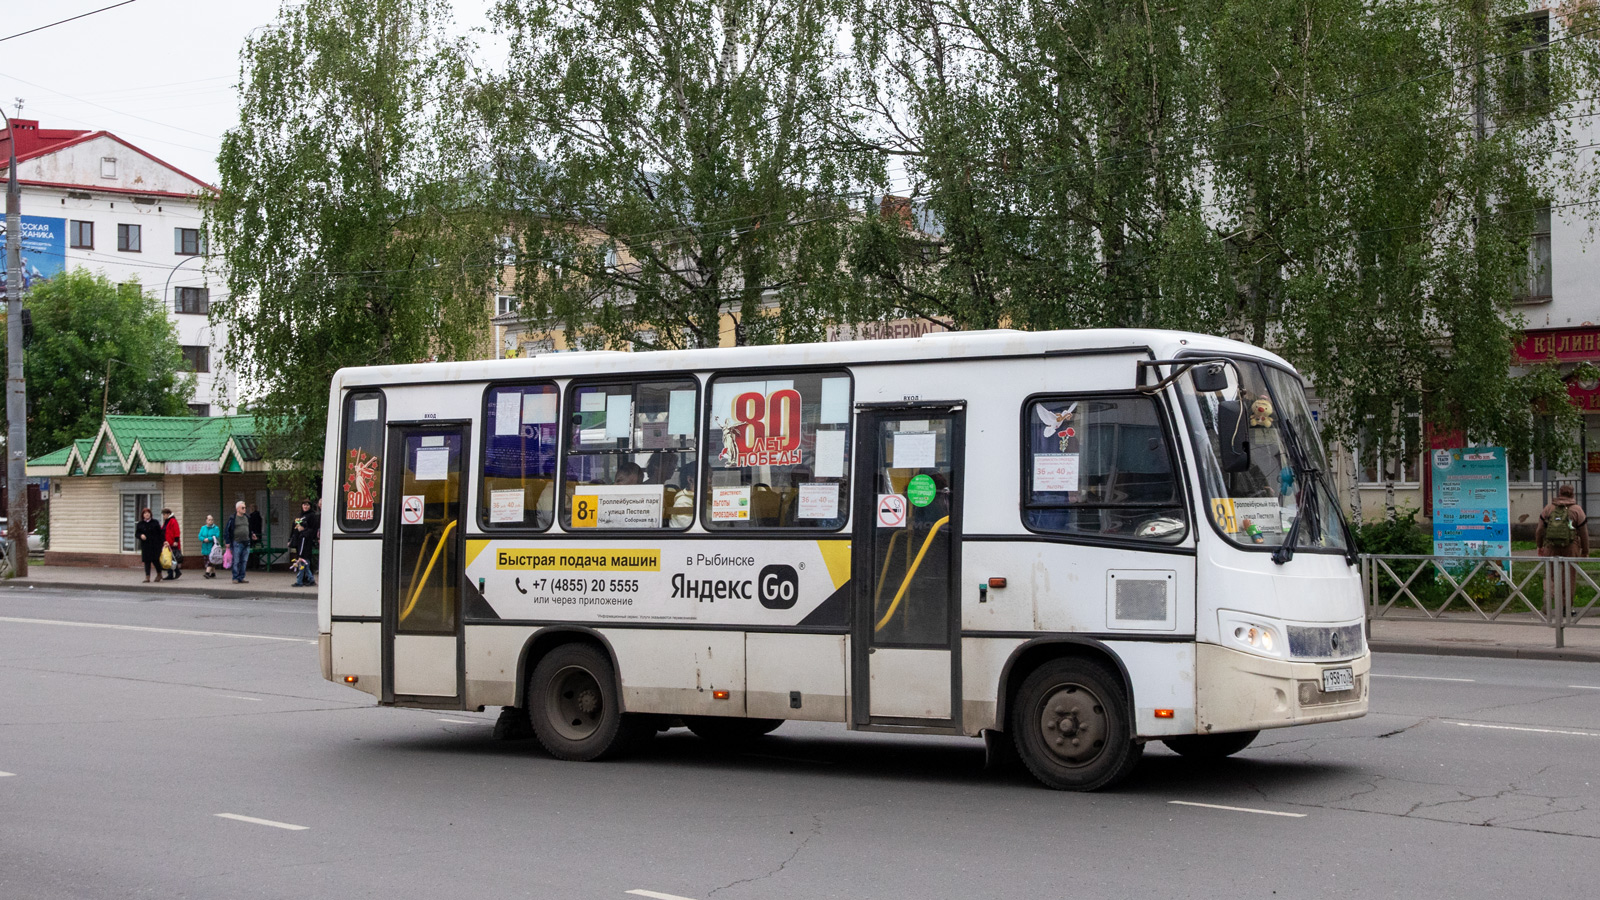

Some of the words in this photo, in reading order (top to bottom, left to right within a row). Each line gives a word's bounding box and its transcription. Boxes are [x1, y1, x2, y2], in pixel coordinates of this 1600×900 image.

[20, 222, 49, 231] ССКАЯ
[731, 388, 801, 453] 80
[753, 436, 786, 451] ЛЕТ
[737, 450, 802, 467] ПОБЕДЫ
[347, 491, 362, 508] 80
[599, 498, 645, 506] Троллейбусный
[346, 510, 373, 521] ПОБЕДА!
[499, 552, 555, 569] Быстрая
[560, 555, 606, 568] подача
[611, 555, 657, 568] машин
[686, 556, 693, 566] в
[697, 553, 755, 567] Рыбинске
[533, 579, 546, 591] +7
[550, 579, 588, 595] (4855)
[591, 579, 605, 592] 20
[609, 580, 639, 593] 5555
[671, 573, 752, 603] Яндекс
[762, 573, 795, 601] Go
[551, 598, 576, 606] через
[579, 598, 633, 607] приложение
